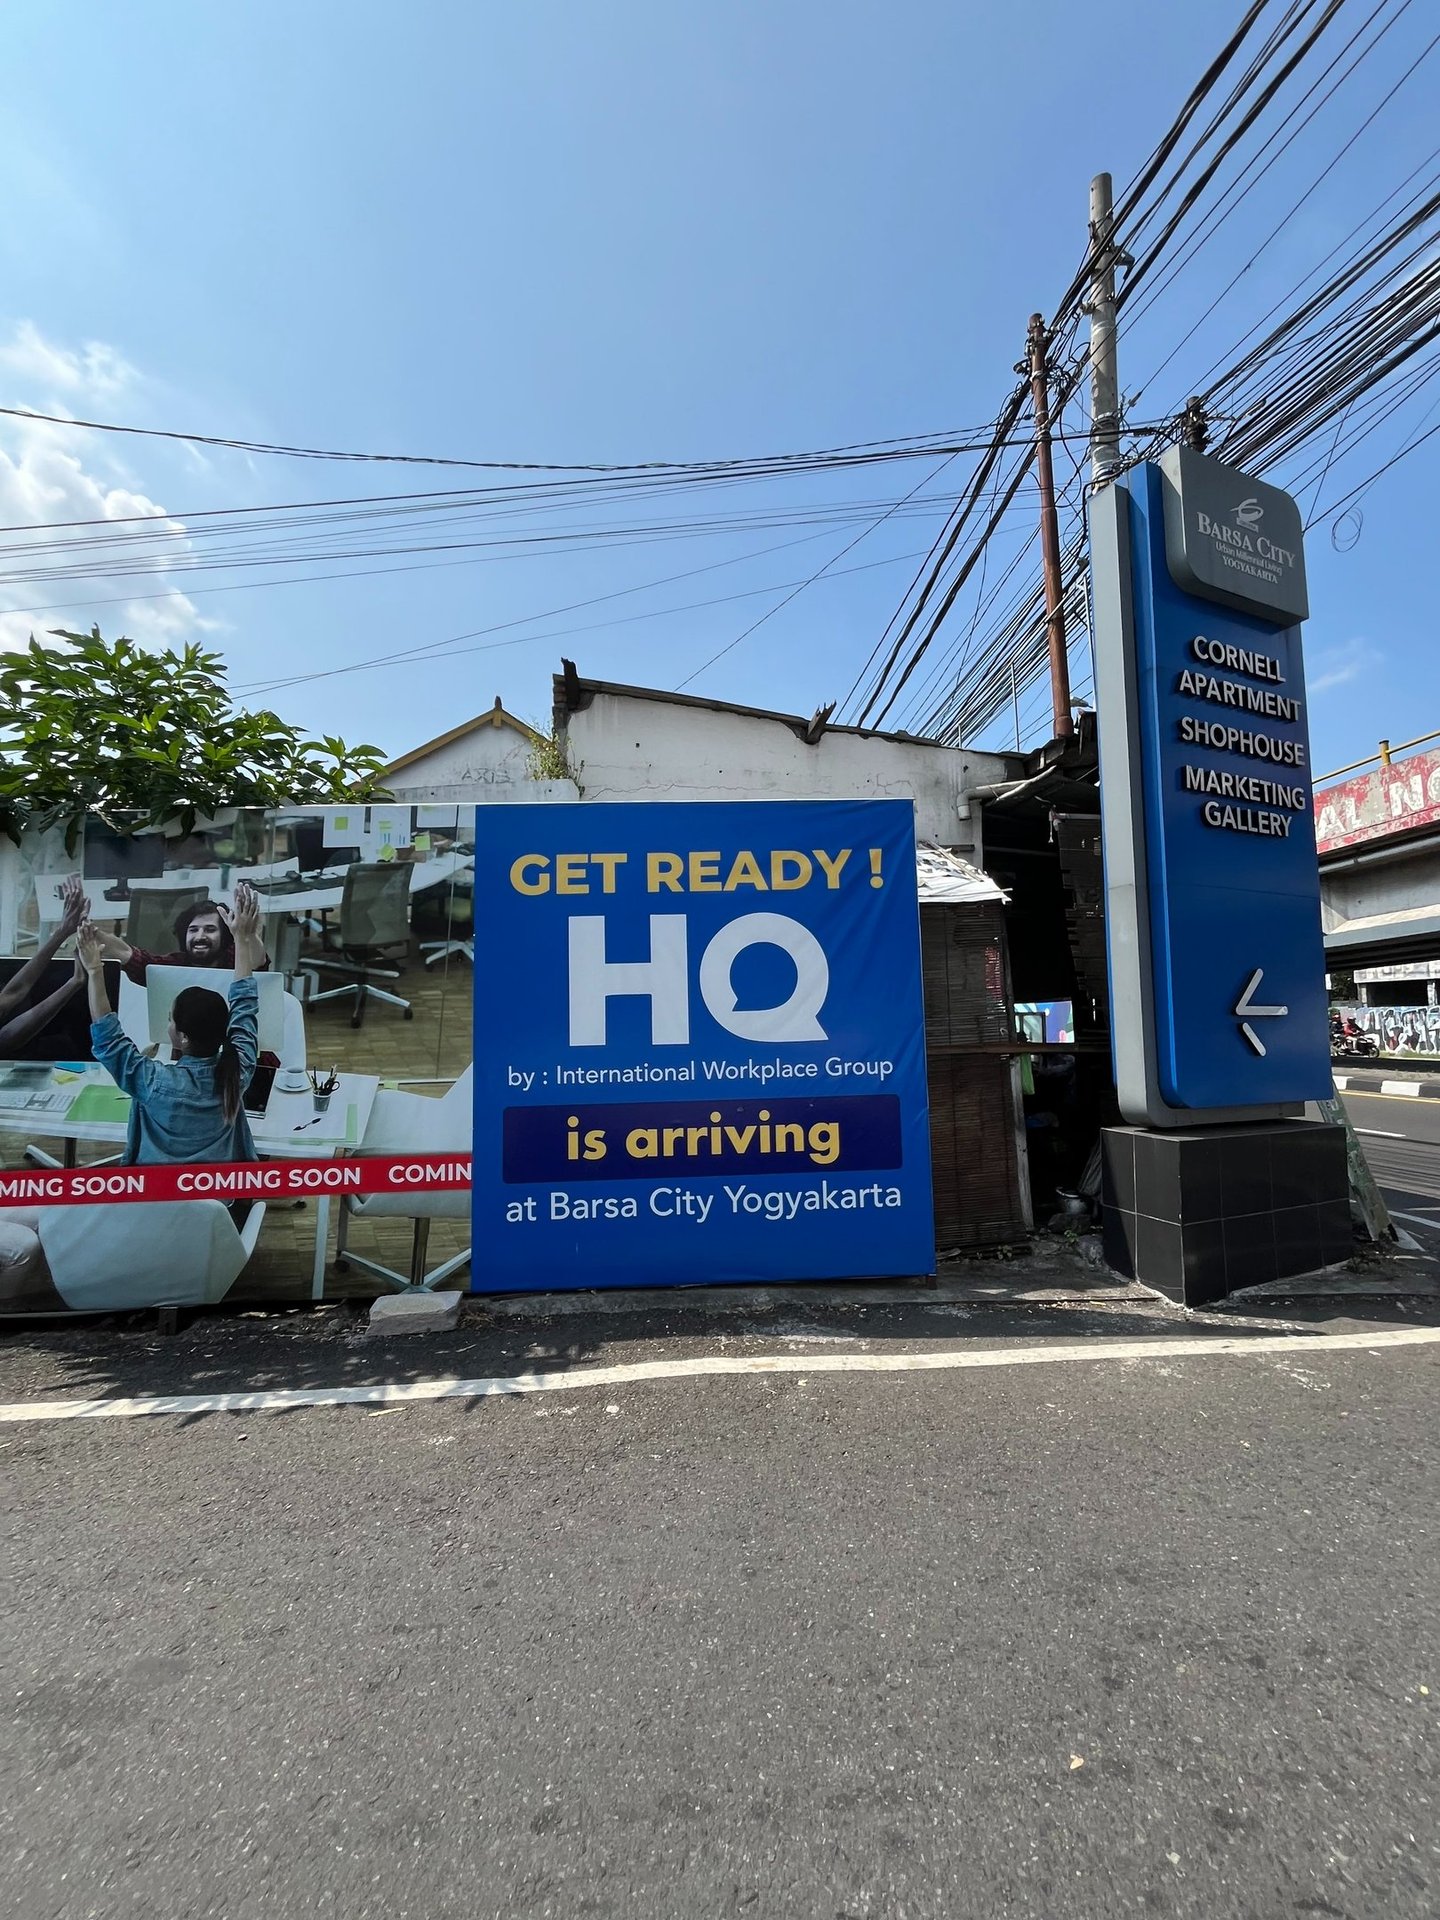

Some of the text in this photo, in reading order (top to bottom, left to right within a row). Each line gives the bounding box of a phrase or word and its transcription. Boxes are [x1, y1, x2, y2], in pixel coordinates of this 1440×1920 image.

[1197, 511, 1296, 568] BARSA CITY
[1193, 635, 1287, 683] CORNELL
[1179, 669, 1302, 721] APARTMENT
[1181, 716, 1306, 766] SHOPHOUSE
[1185, 764, 1306, 810] MARKETING
[1204, 801, 1293, 837] GALLERY
[510, 848, 884, 896] GET READY !
[568, 912, 829, 1047] HQ
[508, 1065, 536, 1091] by
[556, 1061, 696, 1085] International
[702, 1057, 818, 1085] Workplace
[826, 1057, 893, 1081] Group
[567, 1109, 840, 1165] is arriving
[71, 1175, 145, 1196] SOON
[176, 1169, 281, 1192] COMING
[288, 1167, 361, 1188] SOON
[388, 1162, 472, 1184] COMIN
[506, 1180, 902, 1223] at Barsa City Yogyakarta
